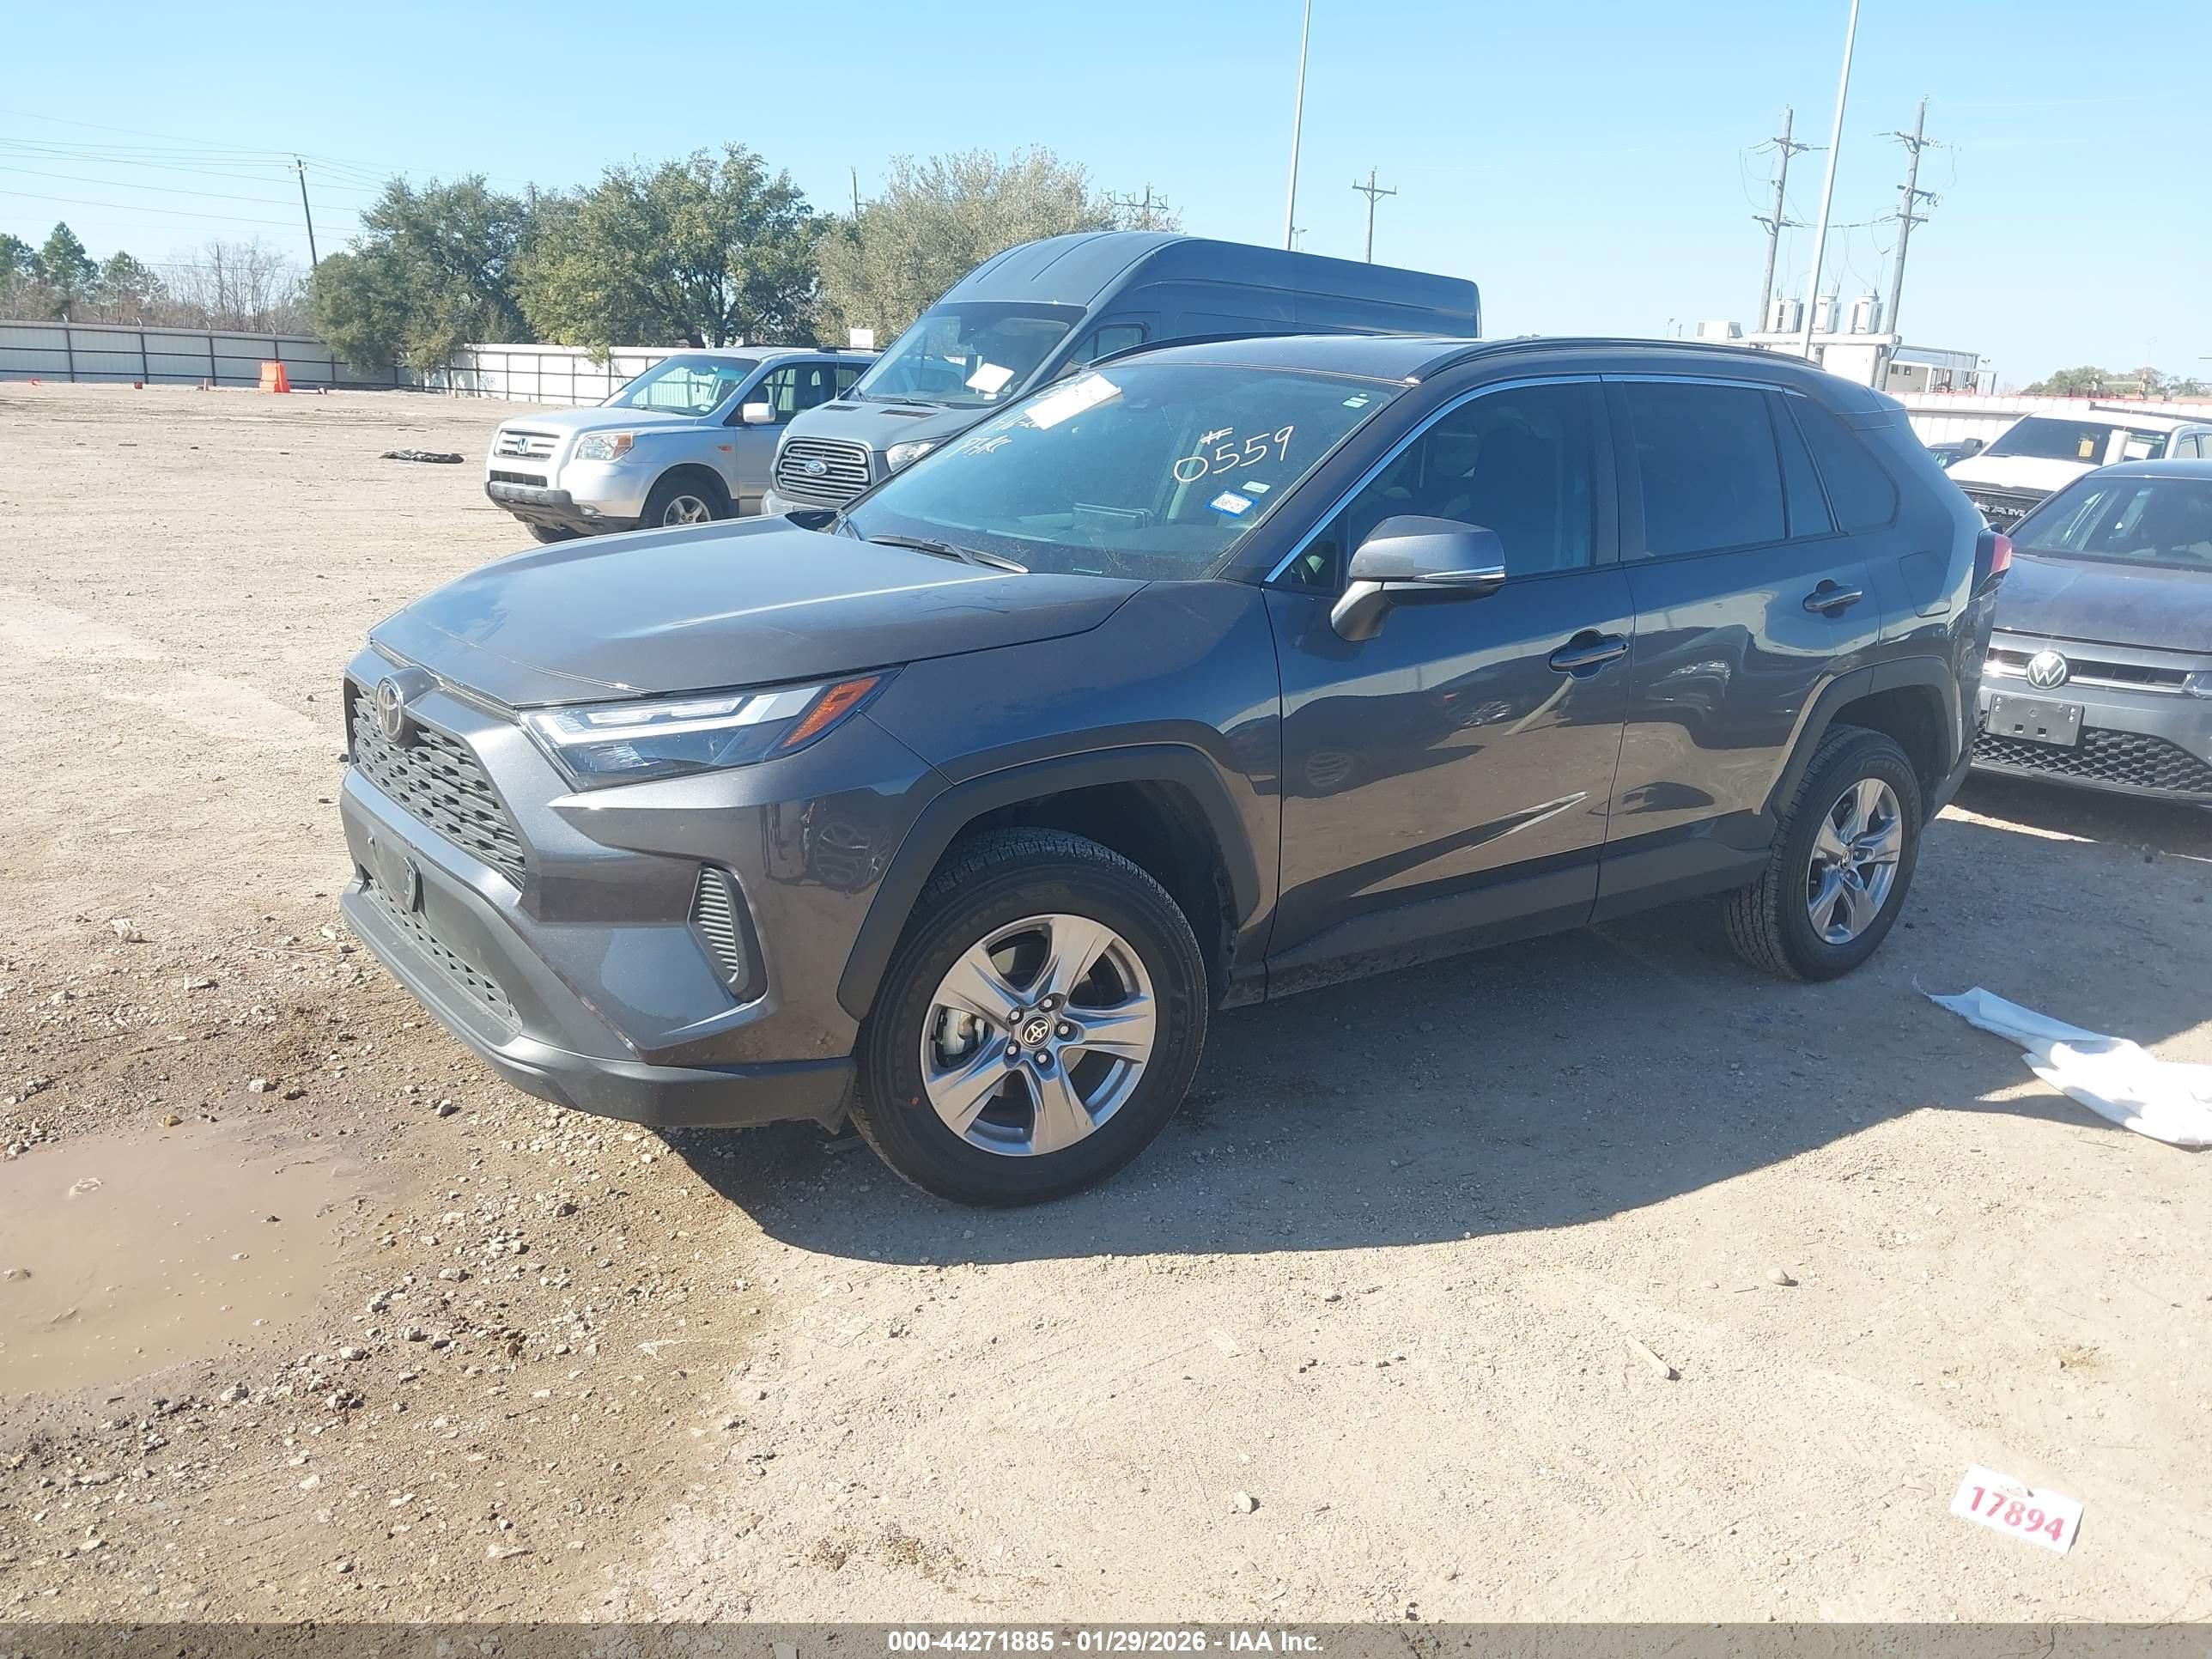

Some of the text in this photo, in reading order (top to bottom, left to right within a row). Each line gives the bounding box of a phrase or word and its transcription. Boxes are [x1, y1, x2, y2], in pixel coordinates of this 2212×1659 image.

[1174, 425, 1294, 483] 0559
[1975, 503, 2027, 517] RAM
[1971, 1486, 2064, 1541] 17894
